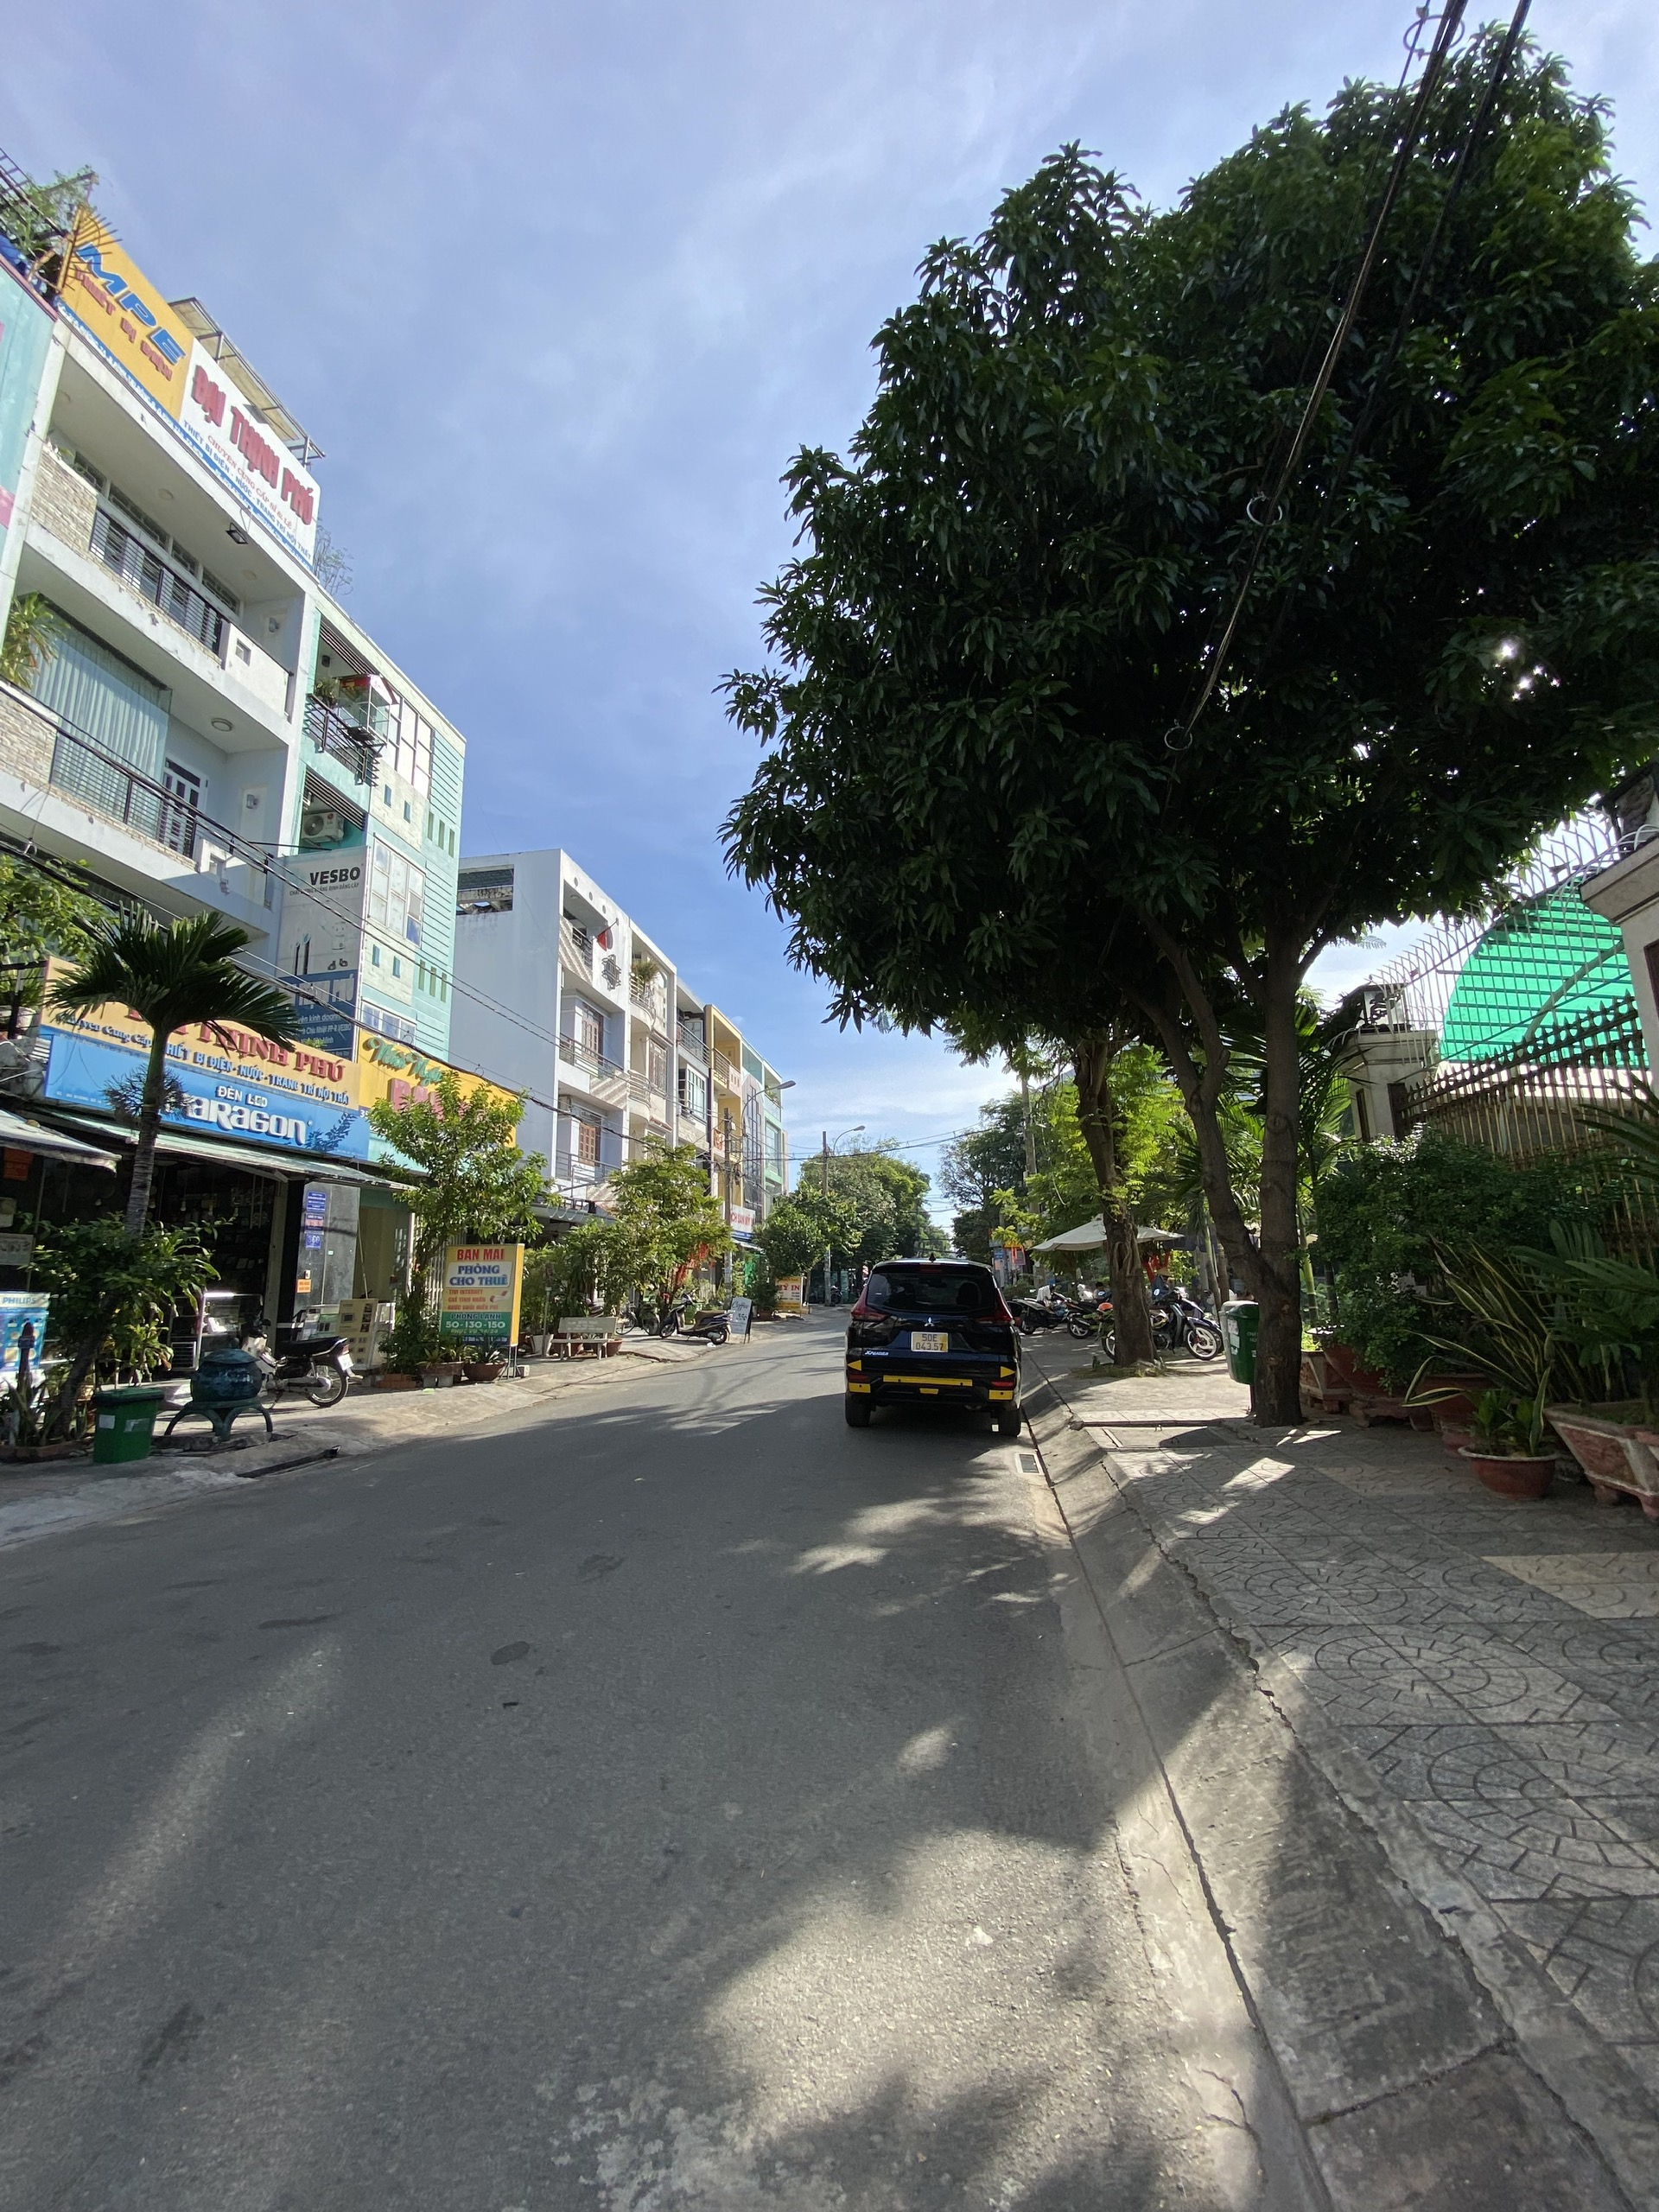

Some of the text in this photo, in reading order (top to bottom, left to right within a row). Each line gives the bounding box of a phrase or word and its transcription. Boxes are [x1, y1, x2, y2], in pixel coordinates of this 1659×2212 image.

[74, 242, 187, 366] MPE
[280, 467, 315, 525] PHÚ
[309, 867, 361, 886] VESBO
[165, 1042, 192, 1061] HIẾT
[207, 1055, 233, 1074] ĐIỆN
[302, 1080, 317, 1098] TRÍ
[295, 1051, 346, 1082] PHÚ
[216, 1084, 268, 1108] ĐÈN LED
[457, 1249, 505, 1261] BAN MAI
[457, 1263, 500, 1274] PHÒNG
[449, 1274, 508, 1286] CHO THUÊ
[916, 1342, 944, 1351] 043.57
[921, 1333, 938, 1343] 50E
